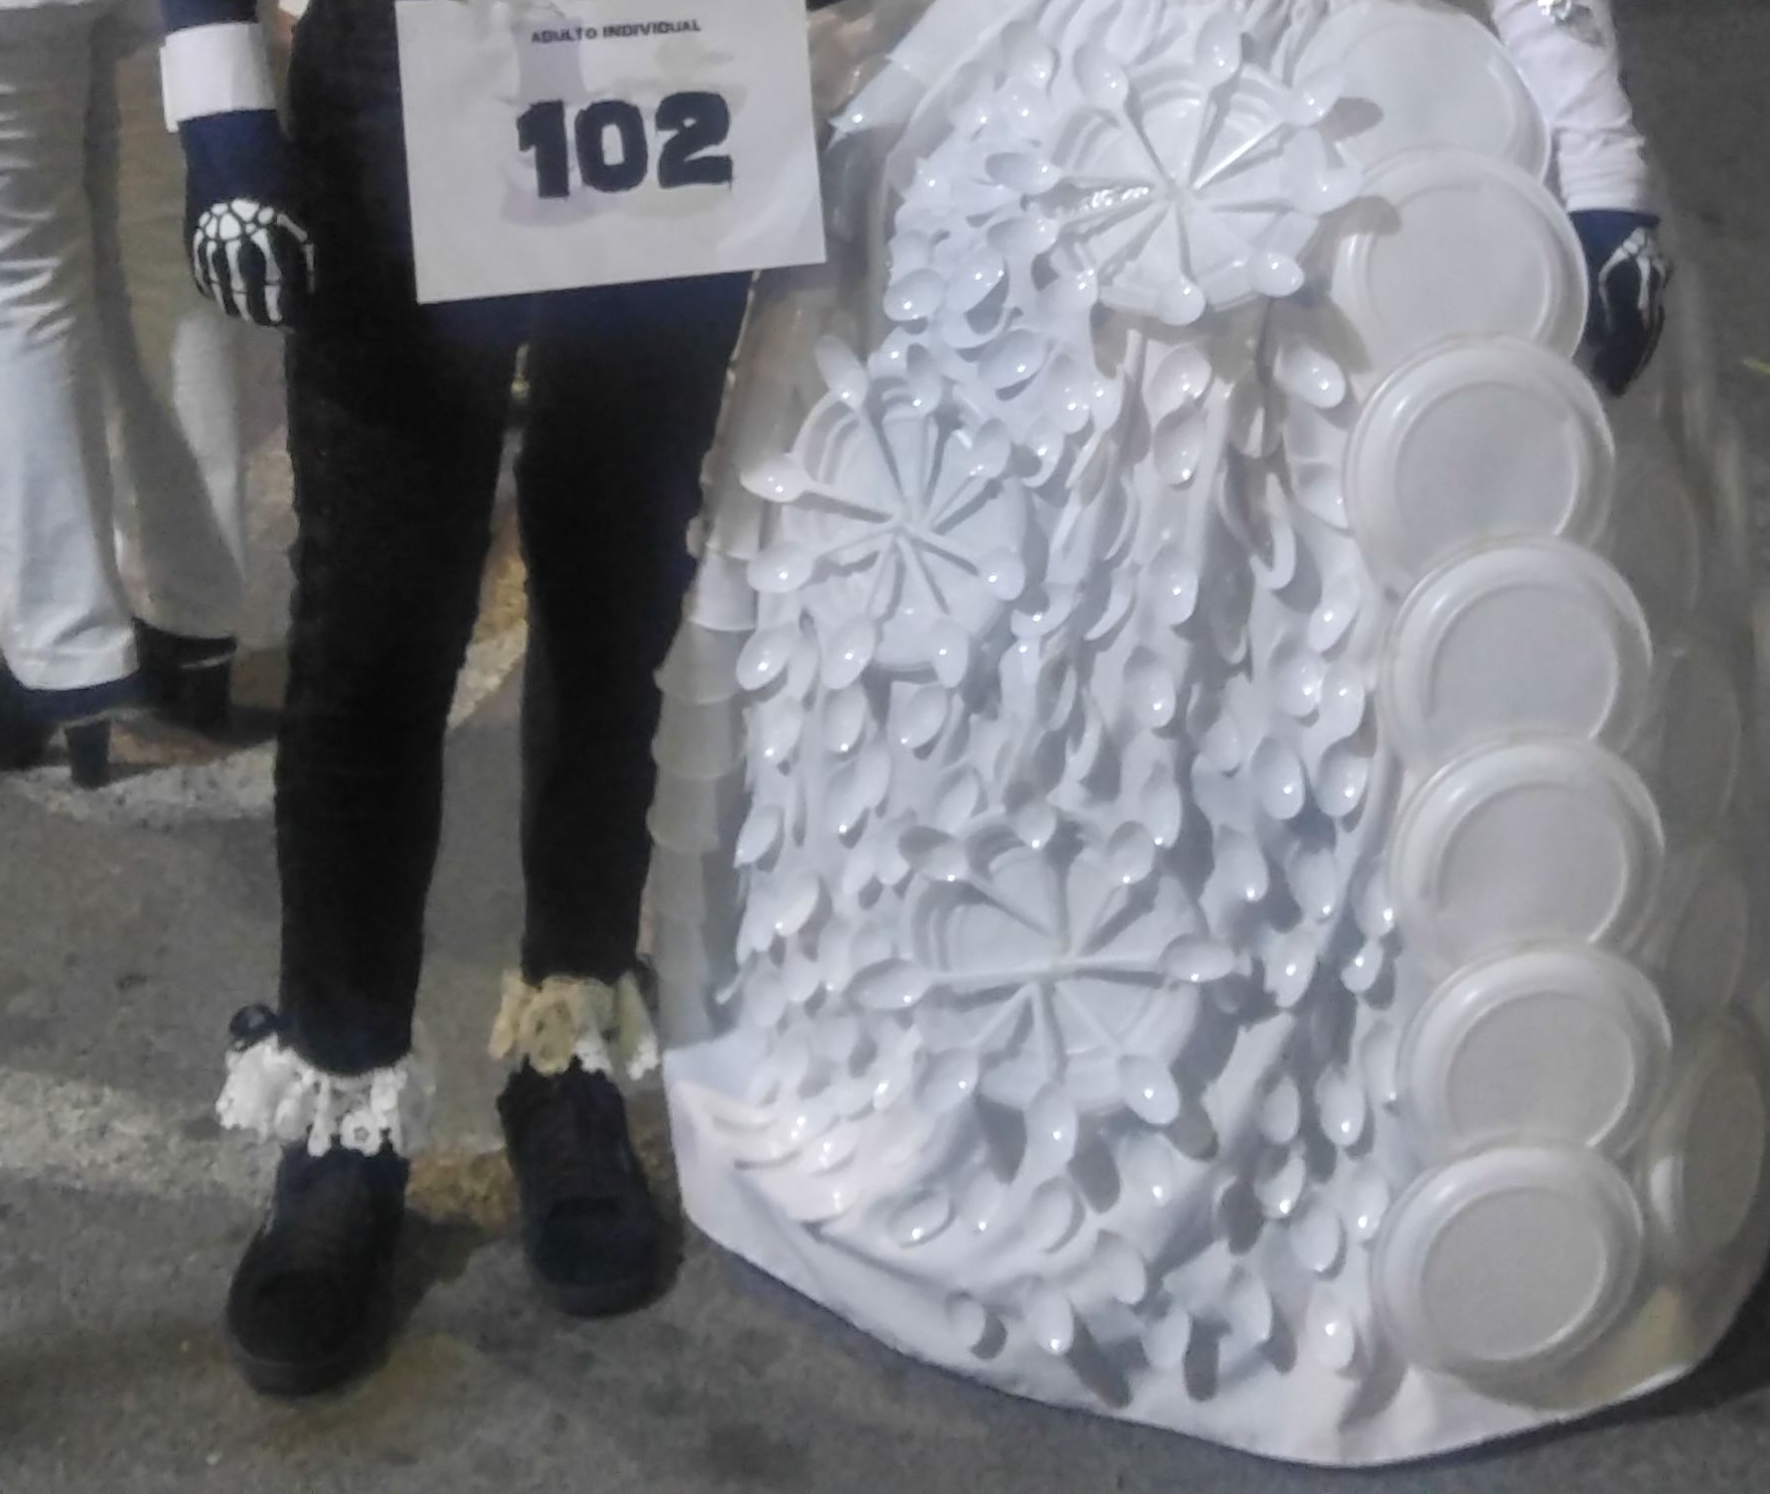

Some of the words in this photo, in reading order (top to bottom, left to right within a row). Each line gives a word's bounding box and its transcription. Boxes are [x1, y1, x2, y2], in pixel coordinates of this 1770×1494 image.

[531, 26, 598, 44] ADULTO
[602, 19, 702, 39] INDIVIDUAL
[516, 92, 733, 198] 102
